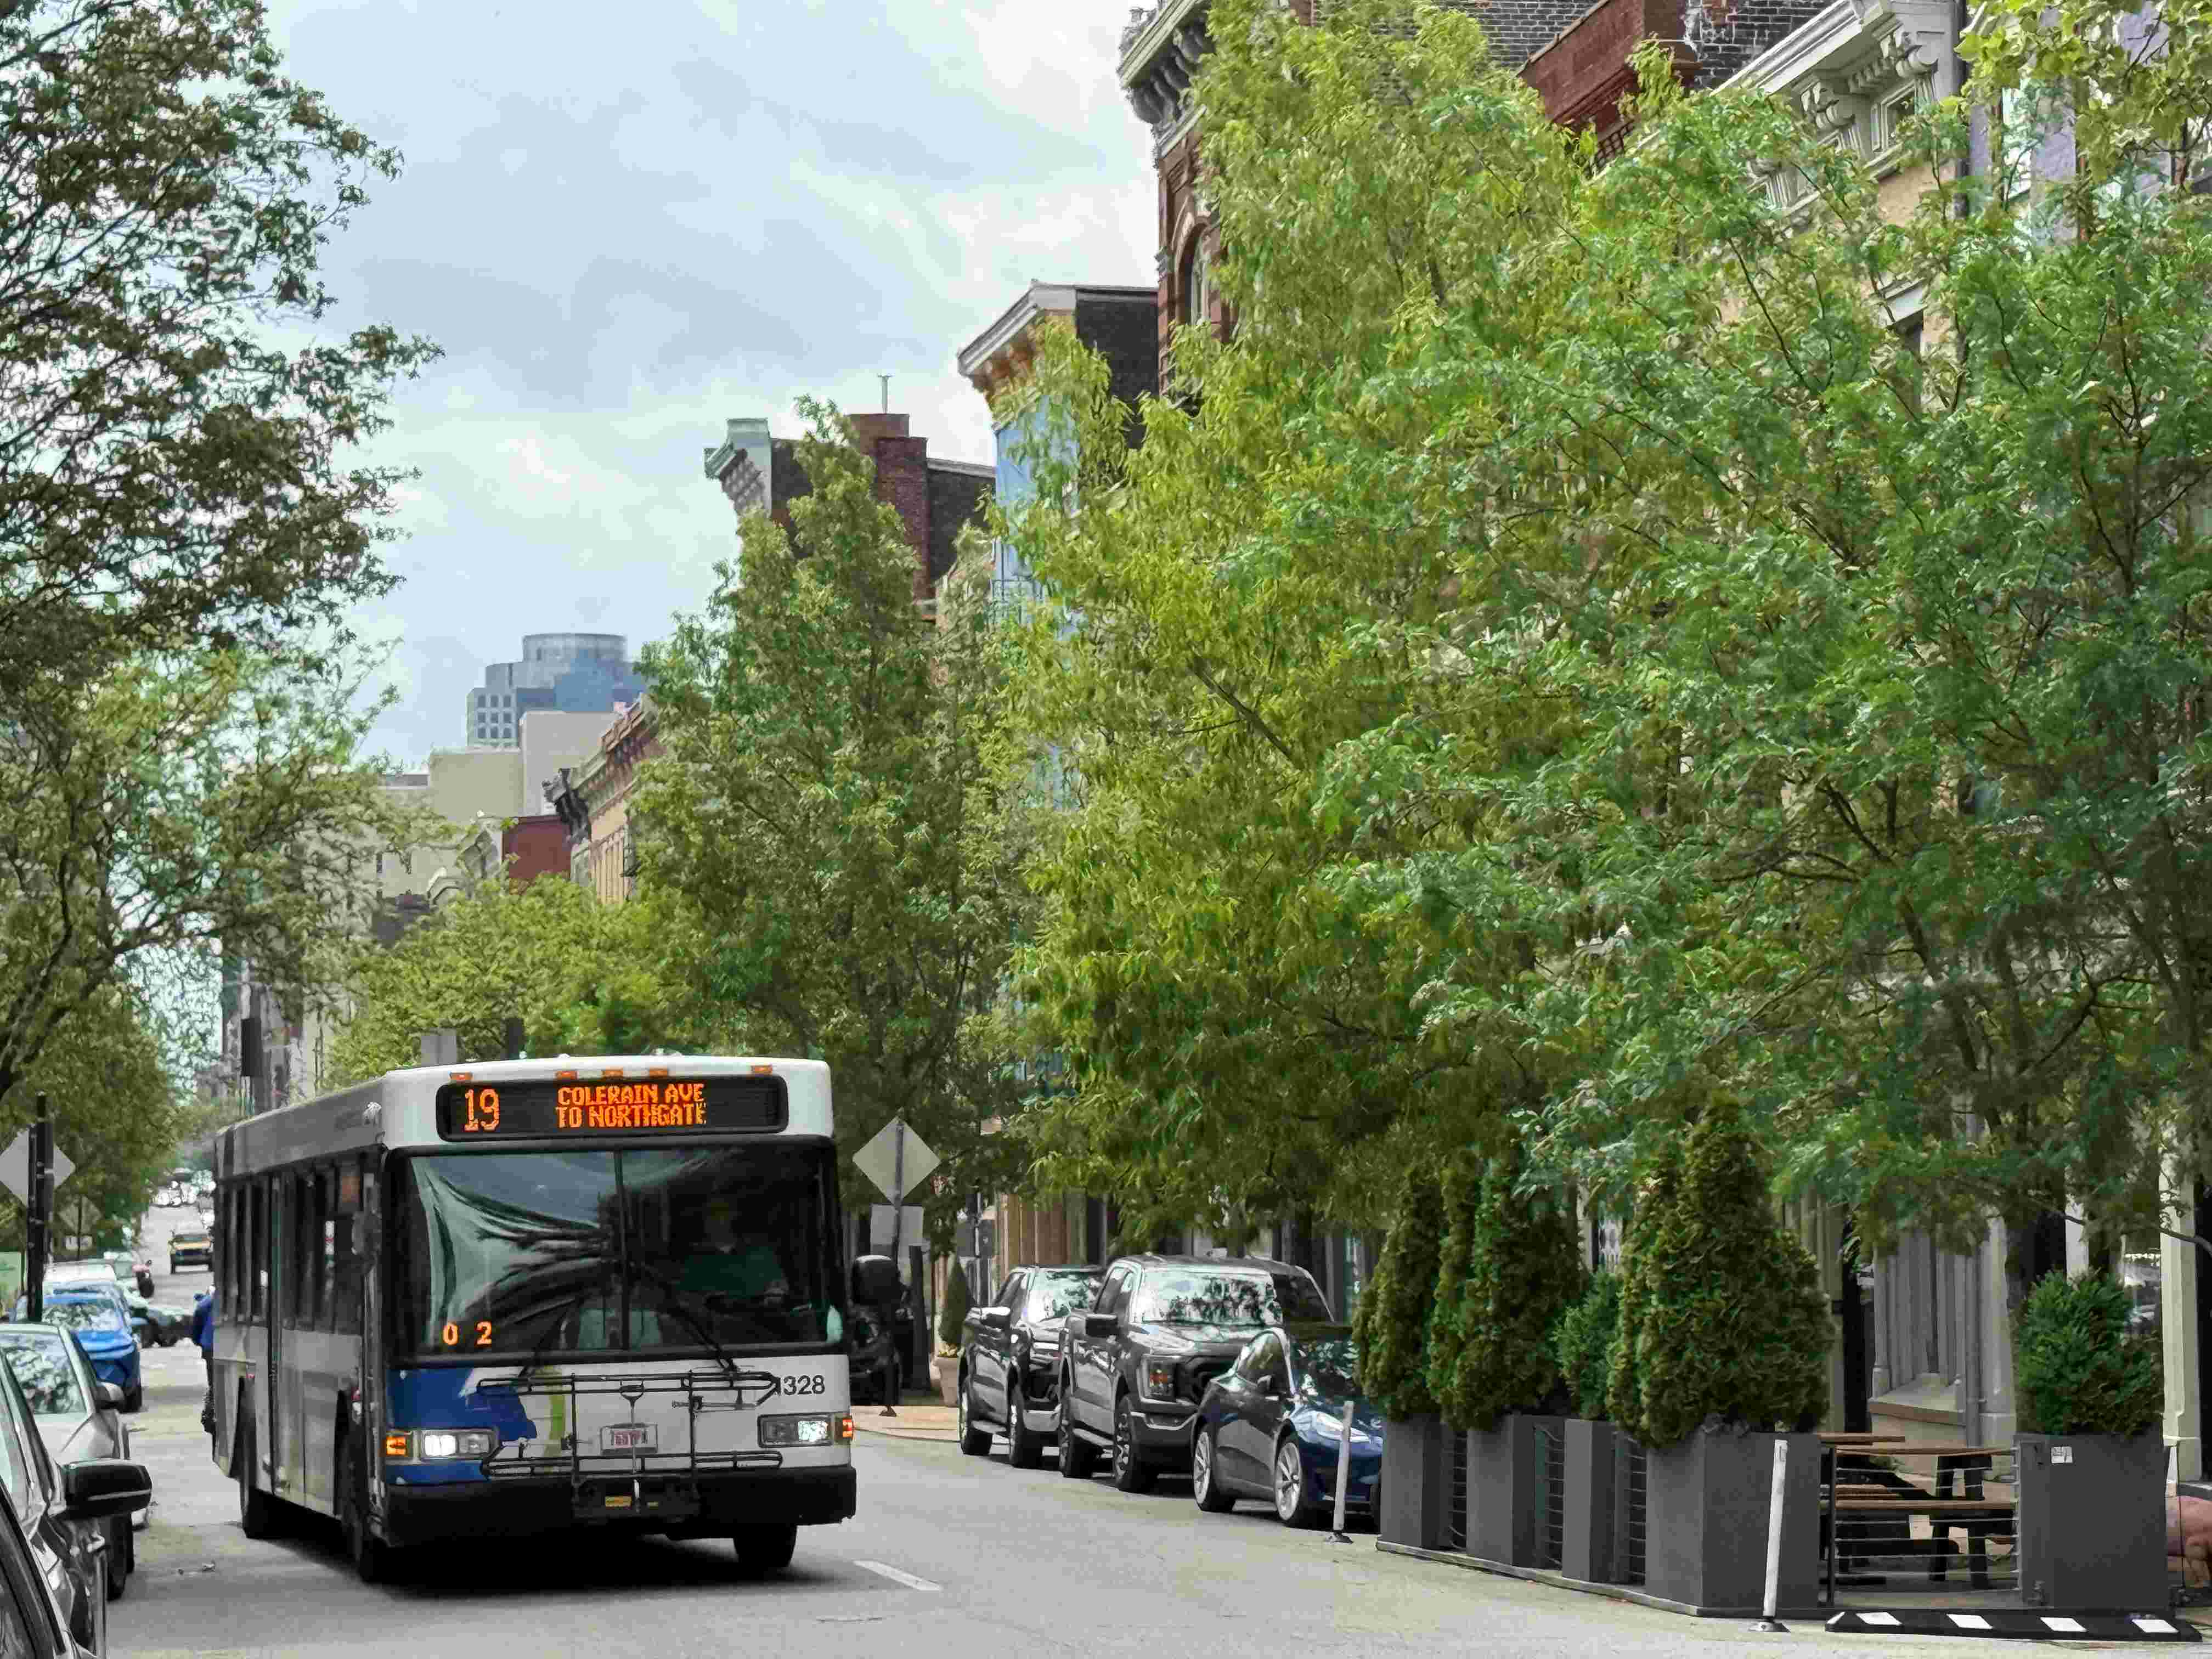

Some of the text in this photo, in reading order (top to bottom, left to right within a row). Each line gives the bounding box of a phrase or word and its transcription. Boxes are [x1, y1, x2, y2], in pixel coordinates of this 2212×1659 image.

[557, 1083, 704, 1105] COLERAIN AVE
[464, 1088, 500, 1132] 19
[555, 1102, 707, 1128] TO NORTHGATE
